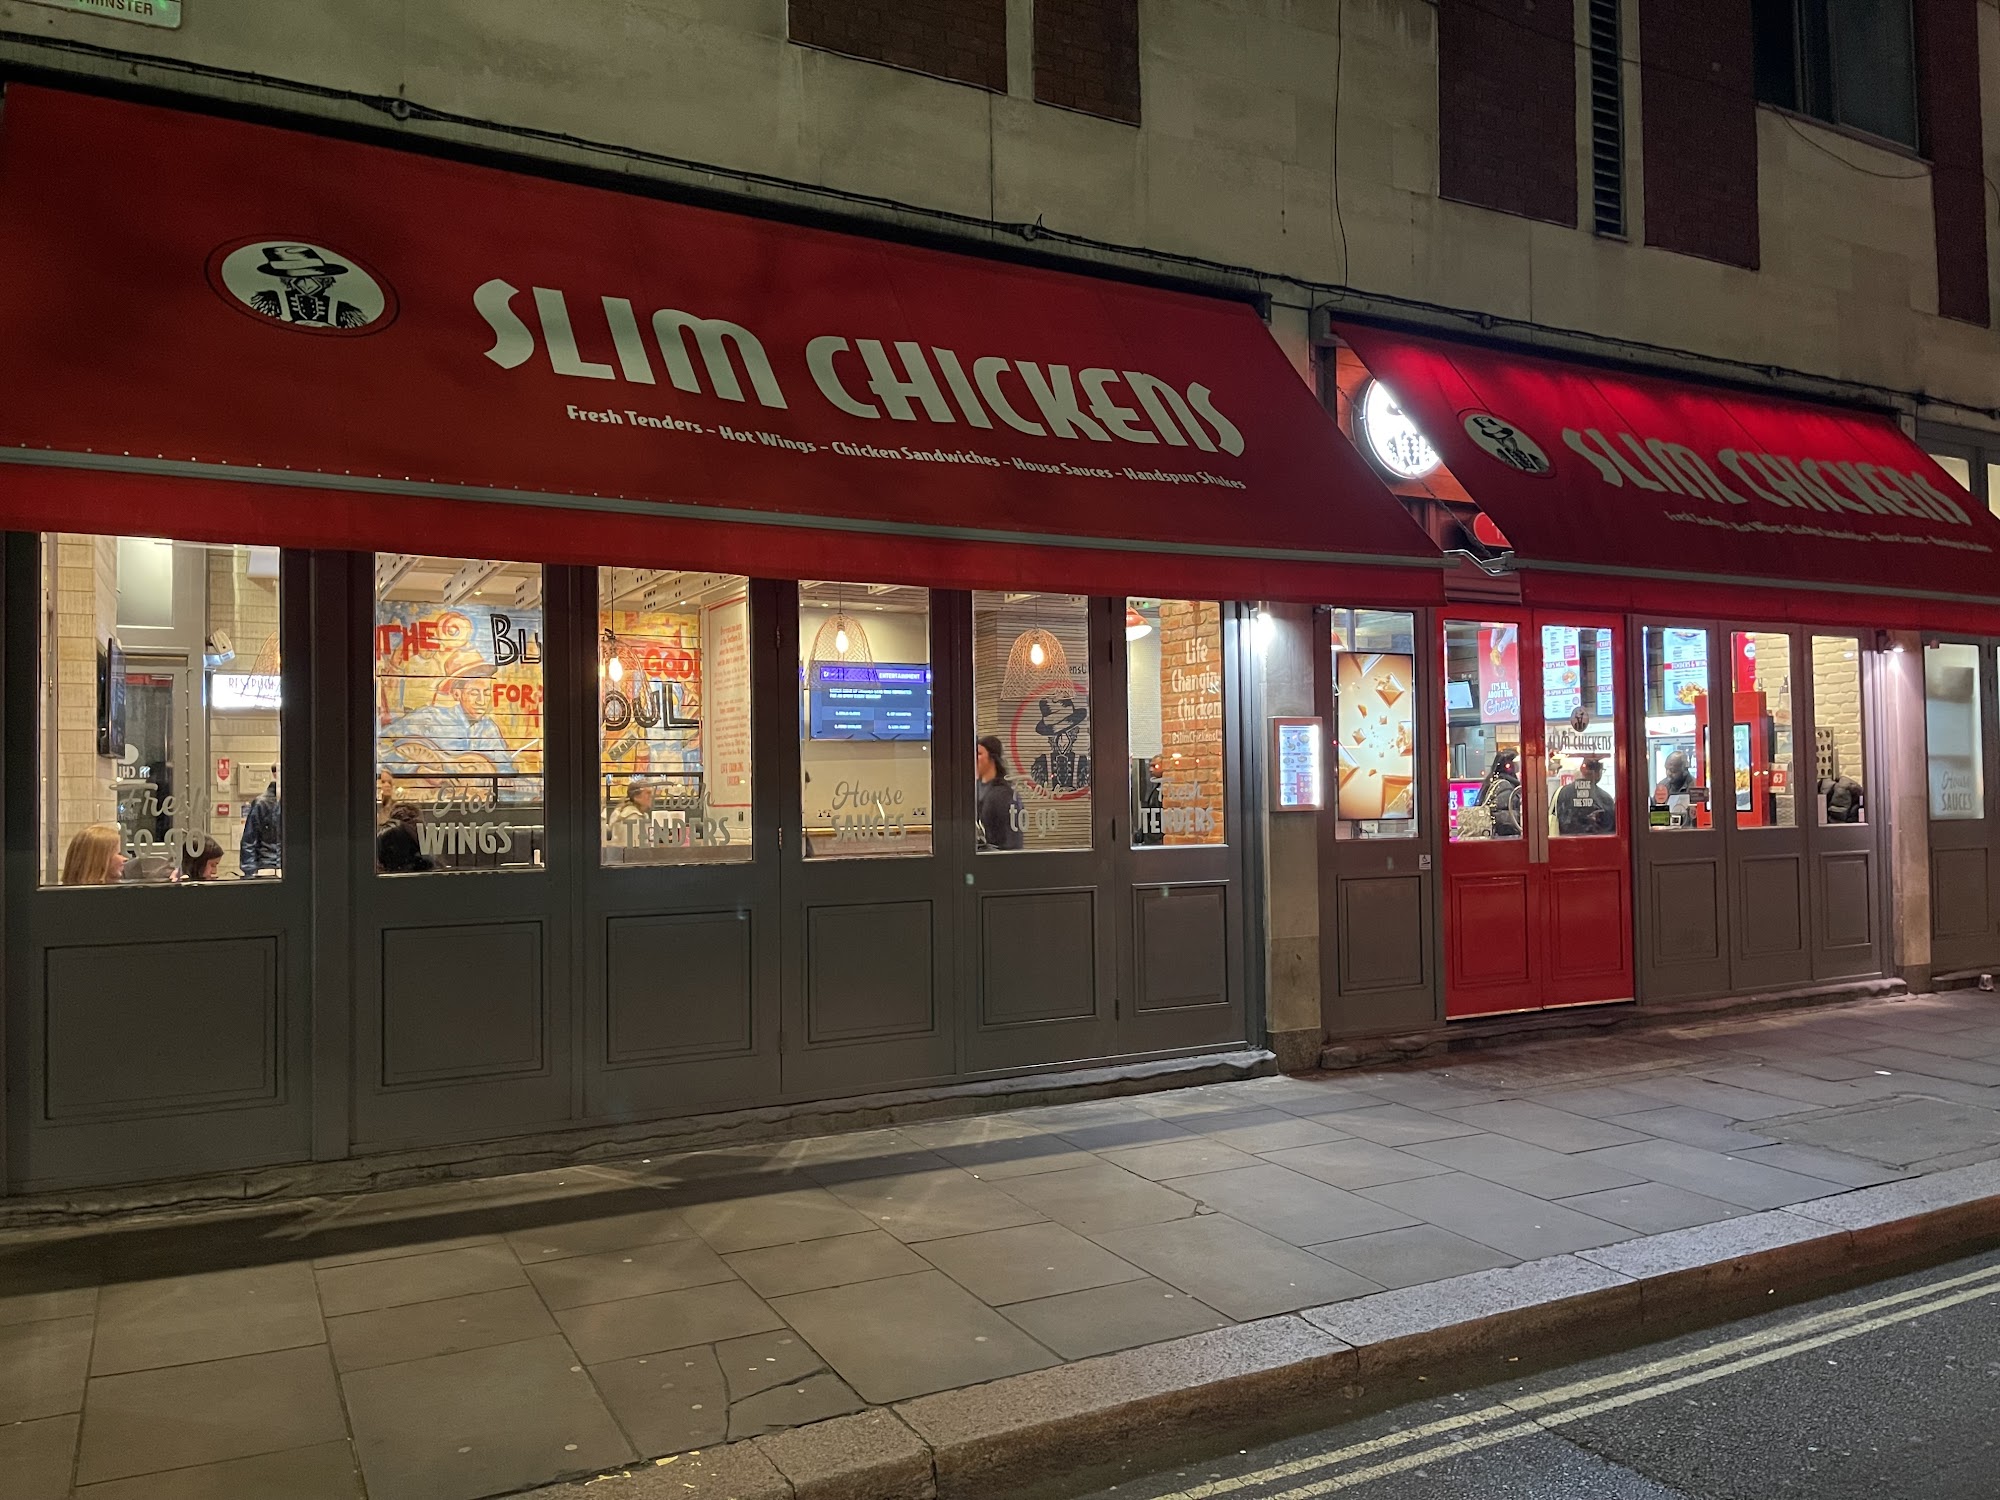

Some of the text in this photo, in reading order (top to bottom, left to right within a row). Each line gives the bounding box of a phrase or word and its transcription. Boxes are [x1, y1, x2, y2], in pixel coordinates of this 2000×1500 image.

[473, 278, 1245, 457] SLIM CHICKENS
[566, 405, 1247, 490] Fresh Tenders Hot Wings Chicken Sandwiches House Sauces Handspun Shakes
[1562, 428, 1972, 526] SLIM CHICKENS
[1185, 637, 1208, 665] Life
[1547, 735, 1612, 751] SLIM CHICKENS
[1150, 776, 1204, 801] Fresh
[1574, 780, 1591, 789] PLEASE
[1773, 772, 1783, 783] 63
[432, 780, 497, 818] Hot
[648, 780, 716, 811] Fresh
[832, 780, 905, 810] House
[1573, 798, 1594, 807] THE STEP
[1942, 793, 1972, 811] SAUCES
[622, 816, 731, 849] TENDERS
[831, 813, 907, 842] SAUCES
[1009, 804, 1059, 838] to go
[1140, 805, 1215, 834] TENDERS
[119, 822, 206, 870] to go
[416, 821, 512, 855] WINGS
